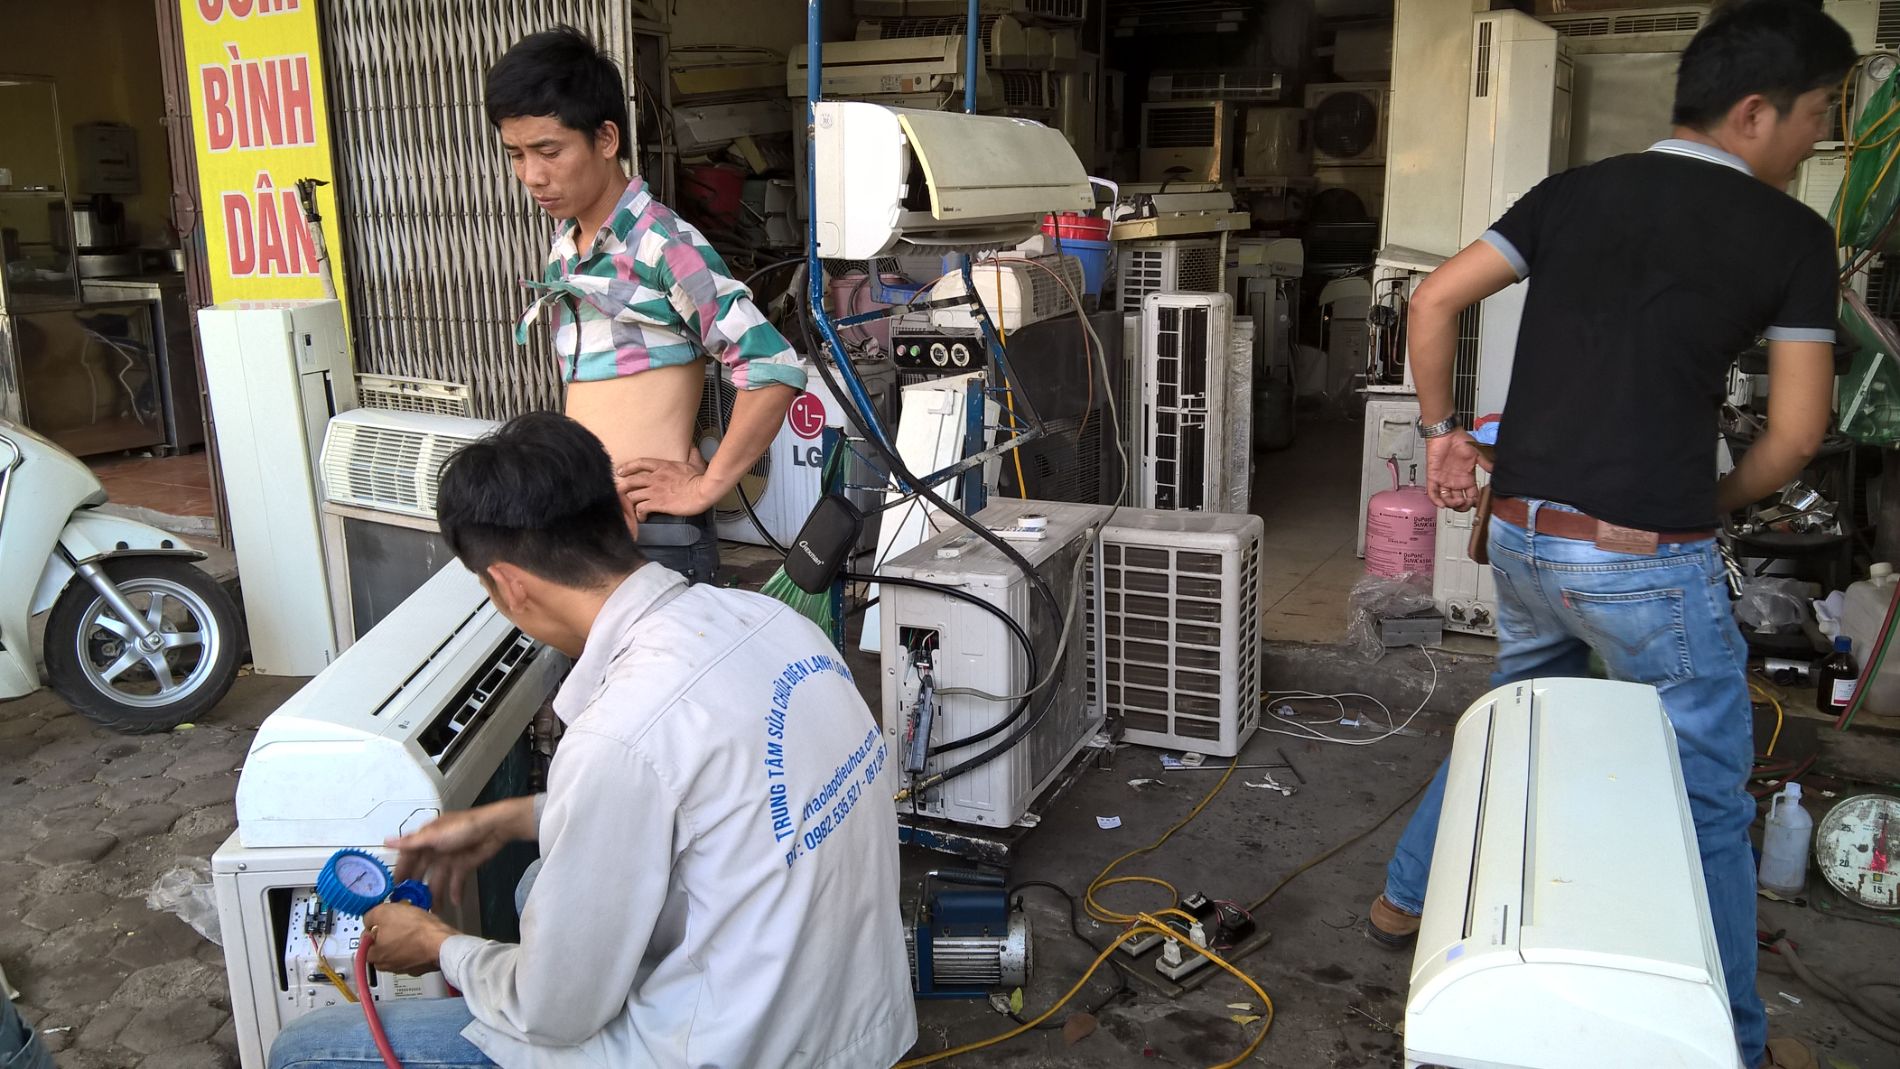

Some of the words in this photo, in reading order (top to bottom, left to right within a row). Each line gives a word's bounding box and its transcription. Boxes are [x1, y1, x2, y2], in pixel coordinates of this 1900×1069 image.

[201, 44, 315, 150] BÌNH
[222, 172, 320, 276] DÂN
[793, 445, 823, 468] LG
[783, 661, 810, 687] ĐIỆN
[803, 654, 834, 674] LẠNH
[765, 742, 785, 779] TÂM
[770, 783, 795, 843] TRUNG
[1873, 885, 1882, 893] 15
